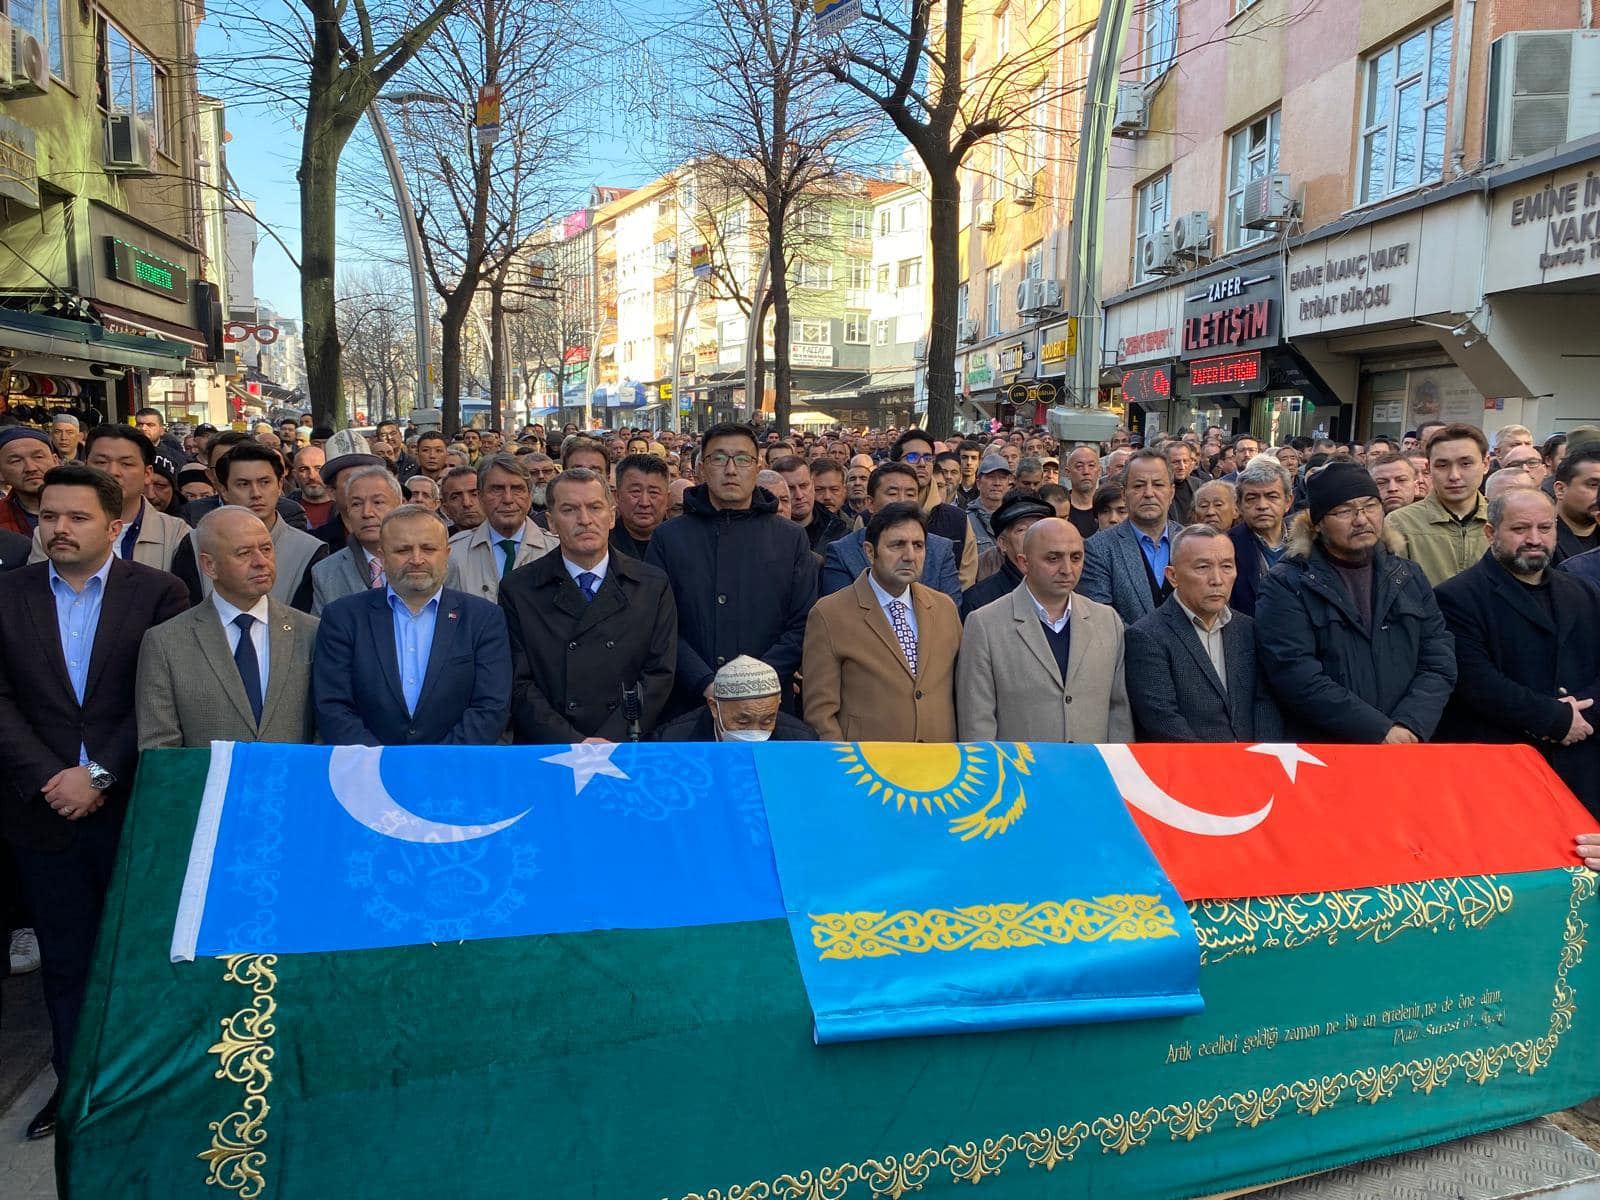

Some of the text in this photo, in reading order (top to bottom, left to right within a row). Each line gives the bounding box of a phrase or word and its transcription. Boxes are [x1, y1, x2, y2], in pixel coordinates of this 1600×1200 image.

[1511, 183, 1578, 227] EMİNE
[1207, 276, 1241, 303] ZAFER
[1289, 264, 1323, 292] EMİNE
[1325, 254, 1368, 283] İNANÇ
[1299, 283, 1391, 321] İRTİBAT BÜROSU
[1183, 299, 1270, 349] İLETİŞİM
[1192, 365, 1219, 386] ZAFER
[1198, 1033, 1239, 1057] ecelleri
[1242, 1026, 1279, 1054] geldiği
[1284, 1023, 1320, 1042] zaman
[1325, 1020, 1340, 1035] ne
[1345, 1013, 1358, 1031] bir
[1363, 1013, 1377, 1028] an
[1441, 995, 1454, 1014] de
[1458, 992, 1476, 1009] öne
